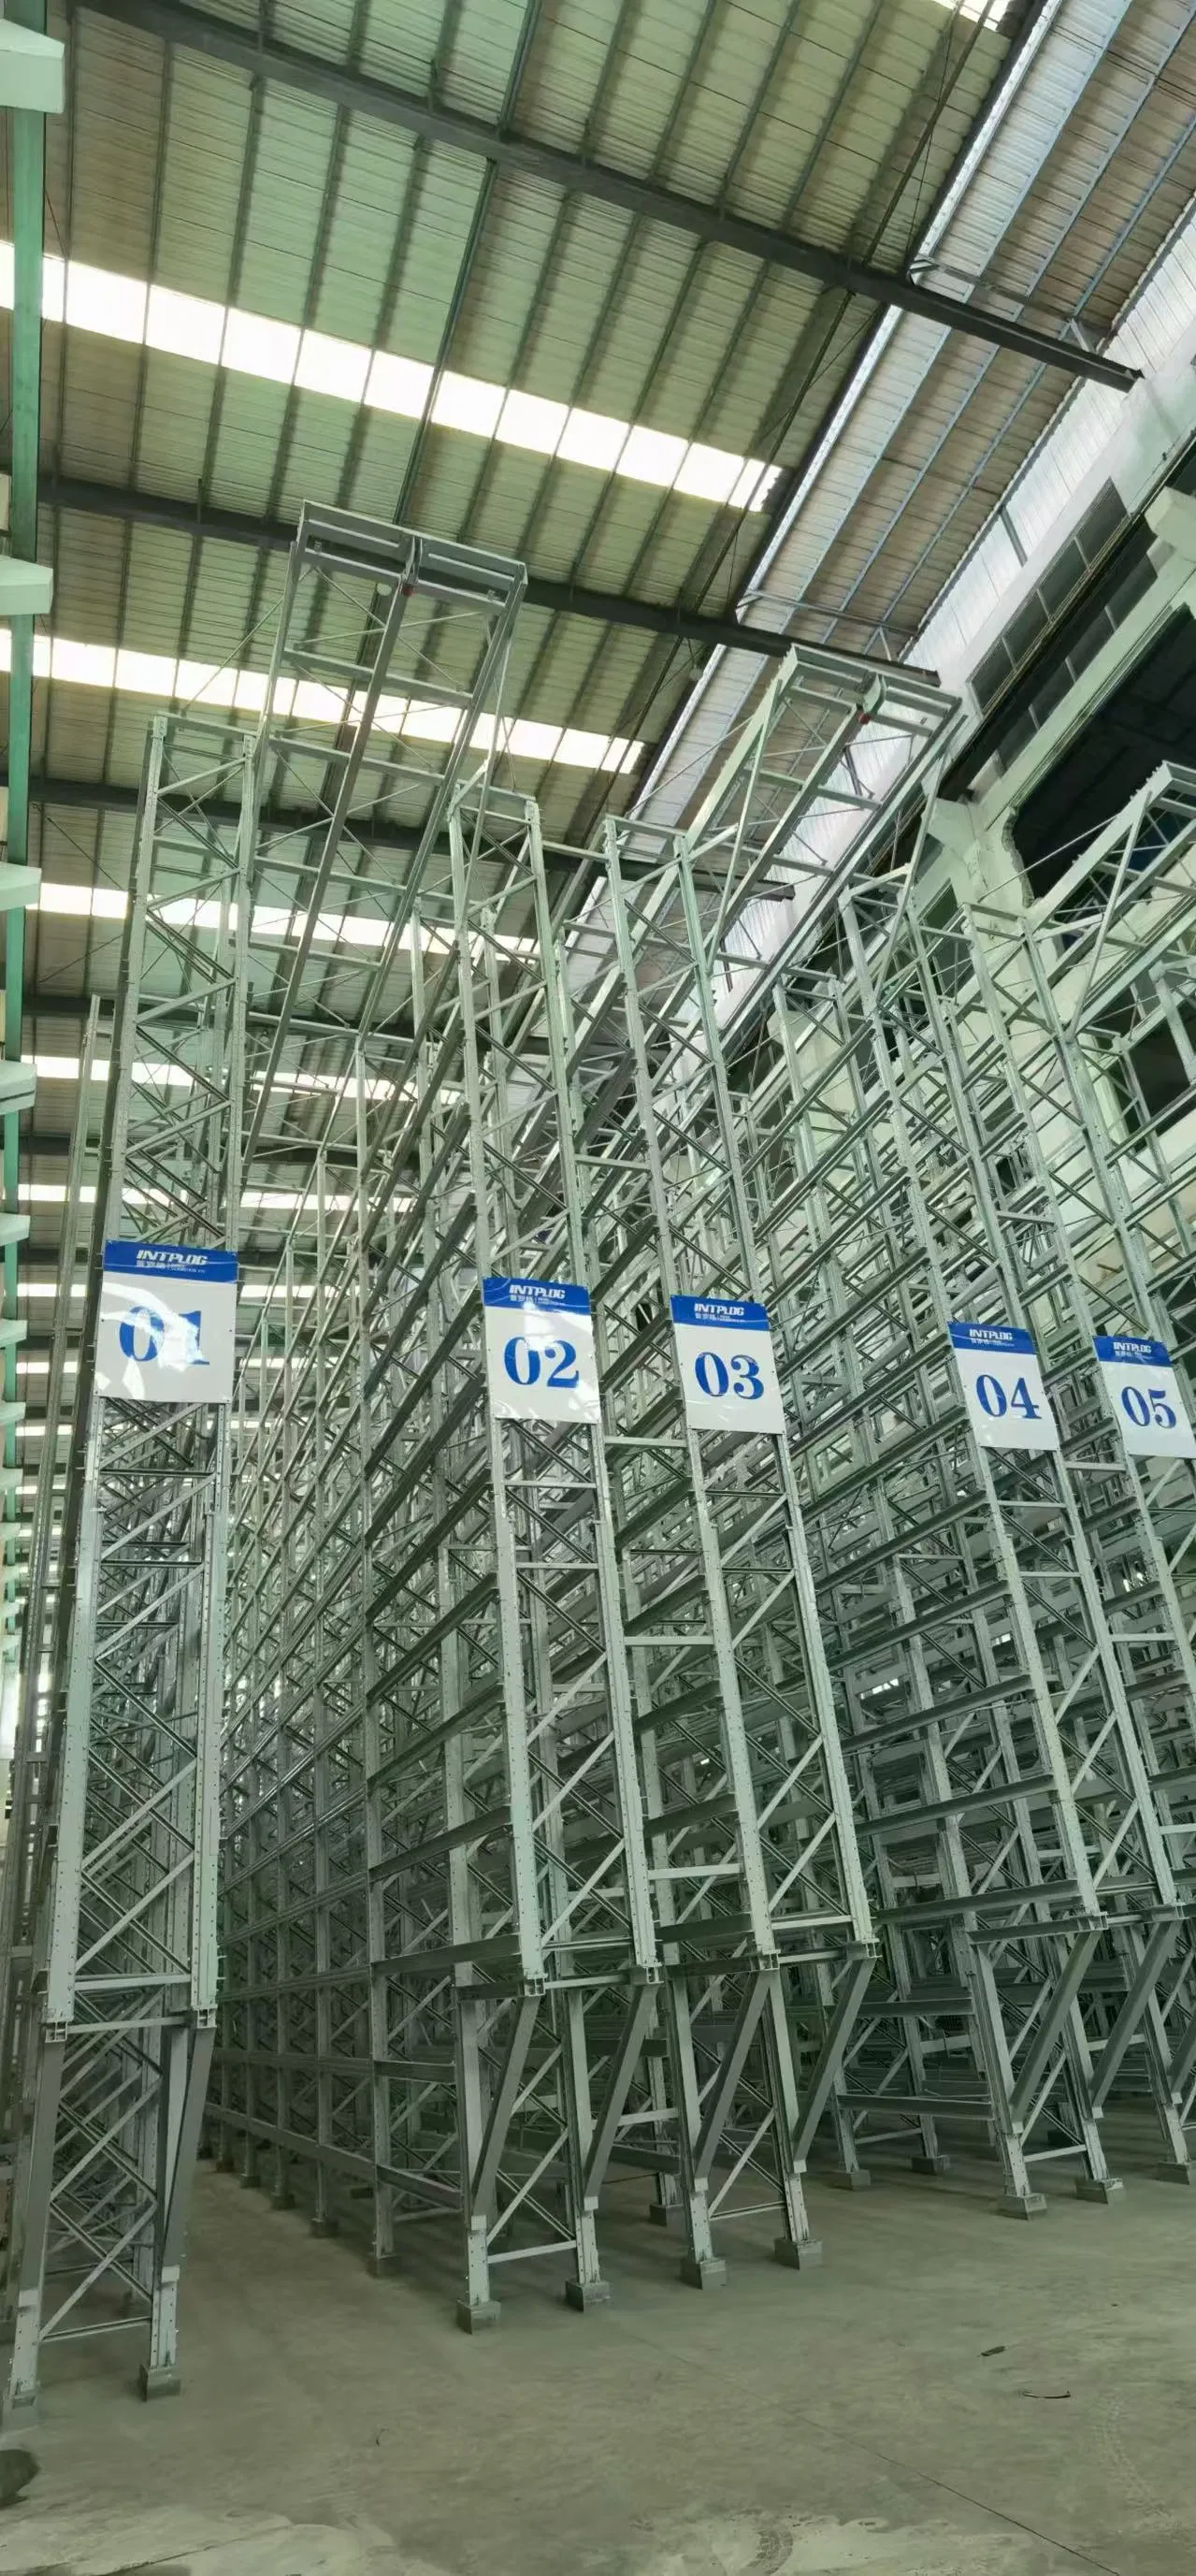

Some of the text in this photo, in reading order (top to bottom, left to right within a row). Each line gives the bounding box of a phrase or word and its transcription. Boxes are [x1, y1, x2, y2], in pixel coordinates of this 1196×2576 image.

[503, 1337, 580, 1389] 02
[695, 1352, 765, 1400] 03
[975, 1374, 1043, 1420] 04
[1121, 1386, 1176, 1429] 05
